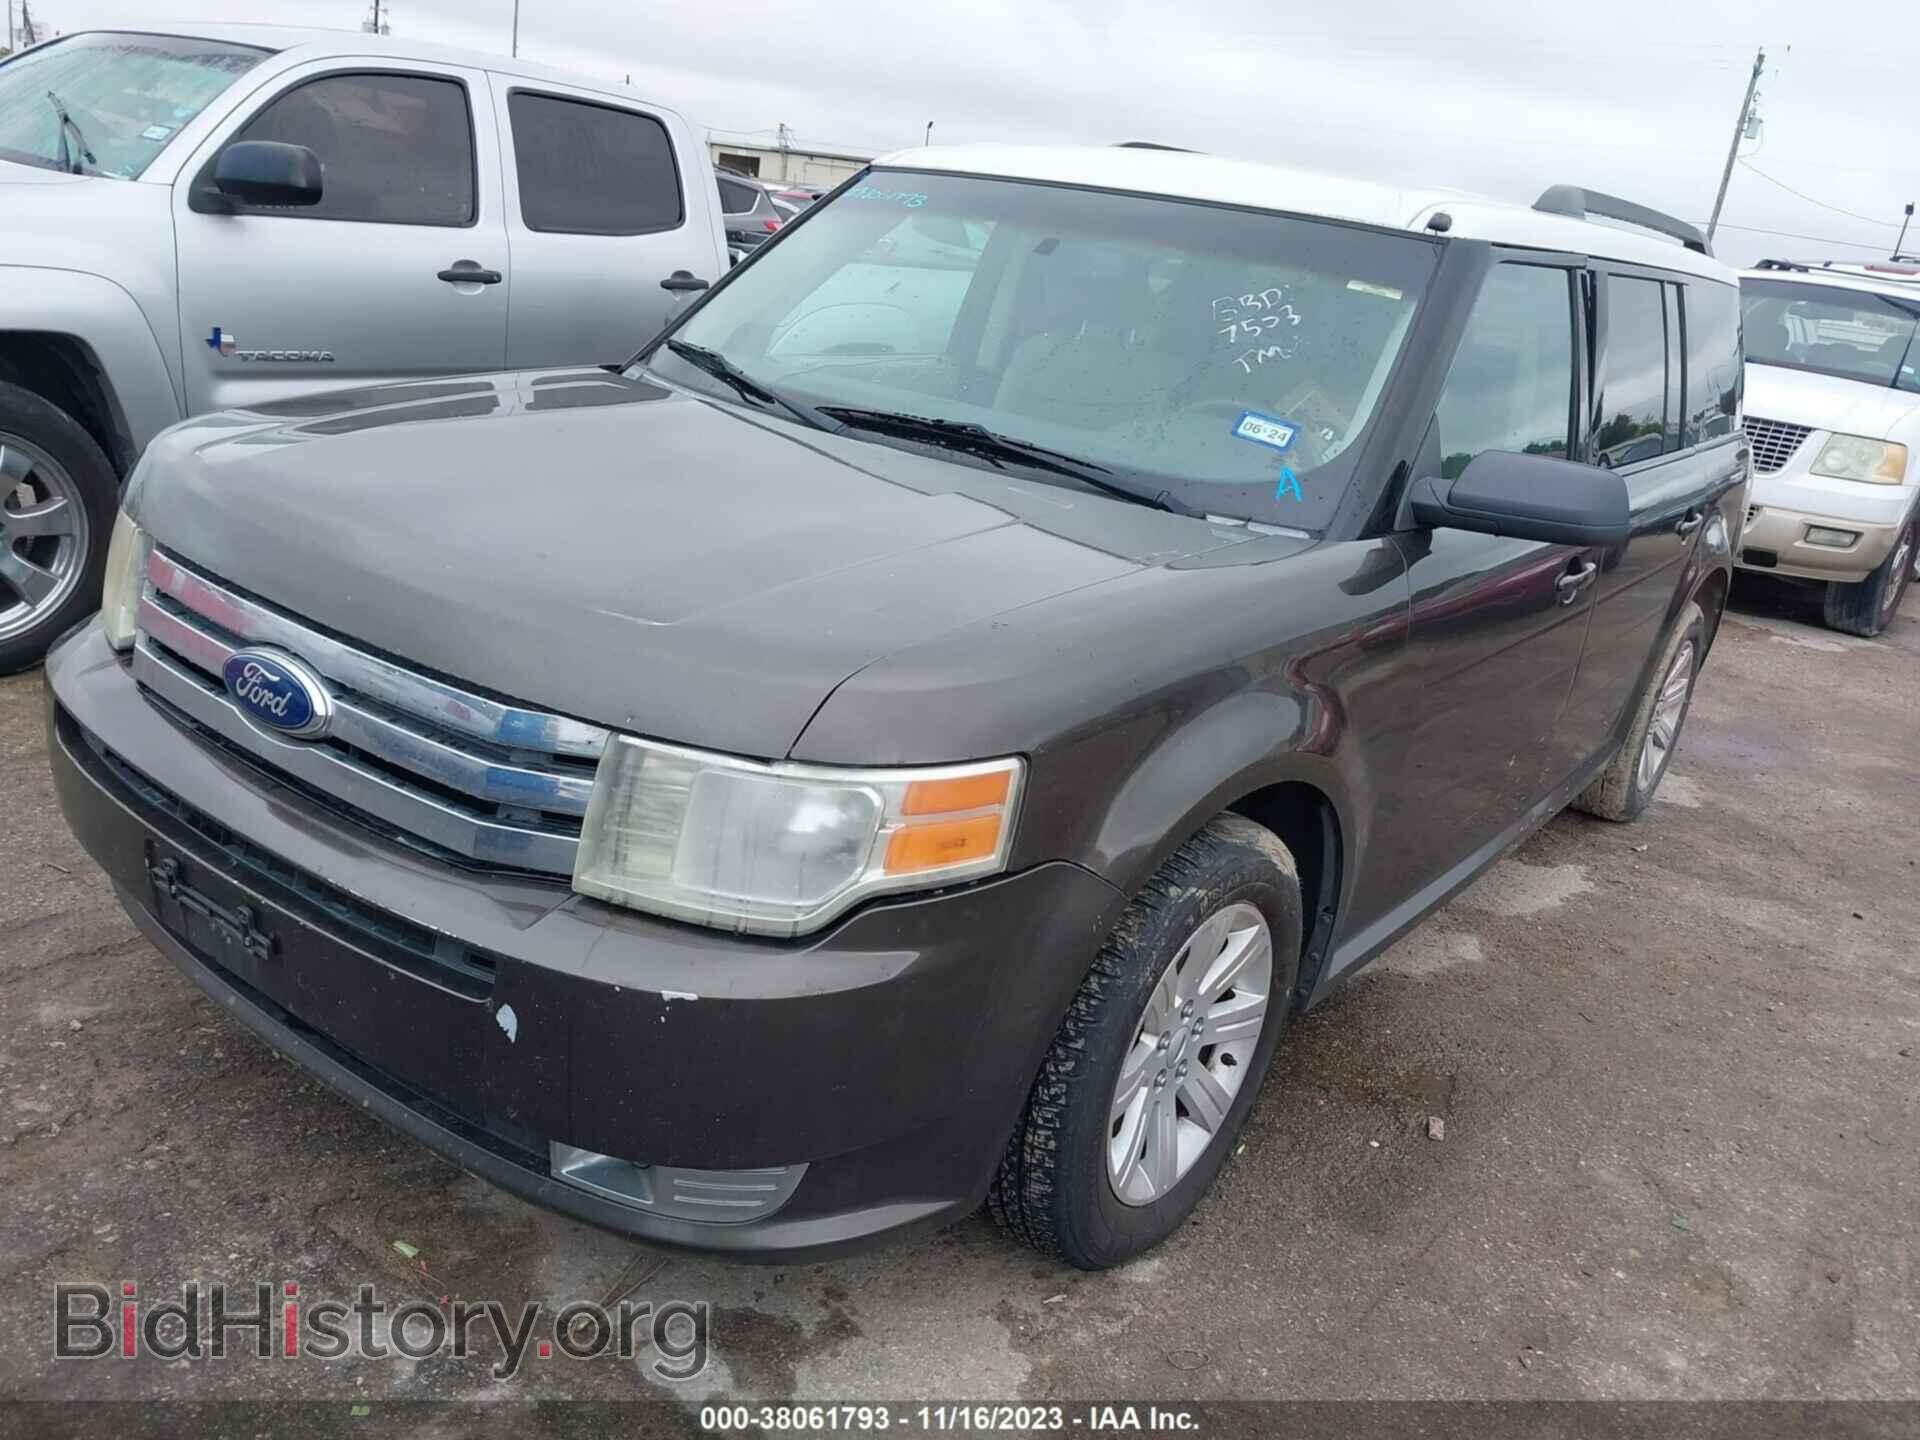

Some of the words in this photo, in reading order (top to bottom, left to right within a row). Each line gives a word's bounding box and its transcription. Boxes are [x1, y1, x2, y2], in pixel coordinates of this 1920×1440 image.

[235, 350, 335, 362] TACOMA
[1275, 465, 1303, 503] A
[235, 662, 293, 717] Ford
